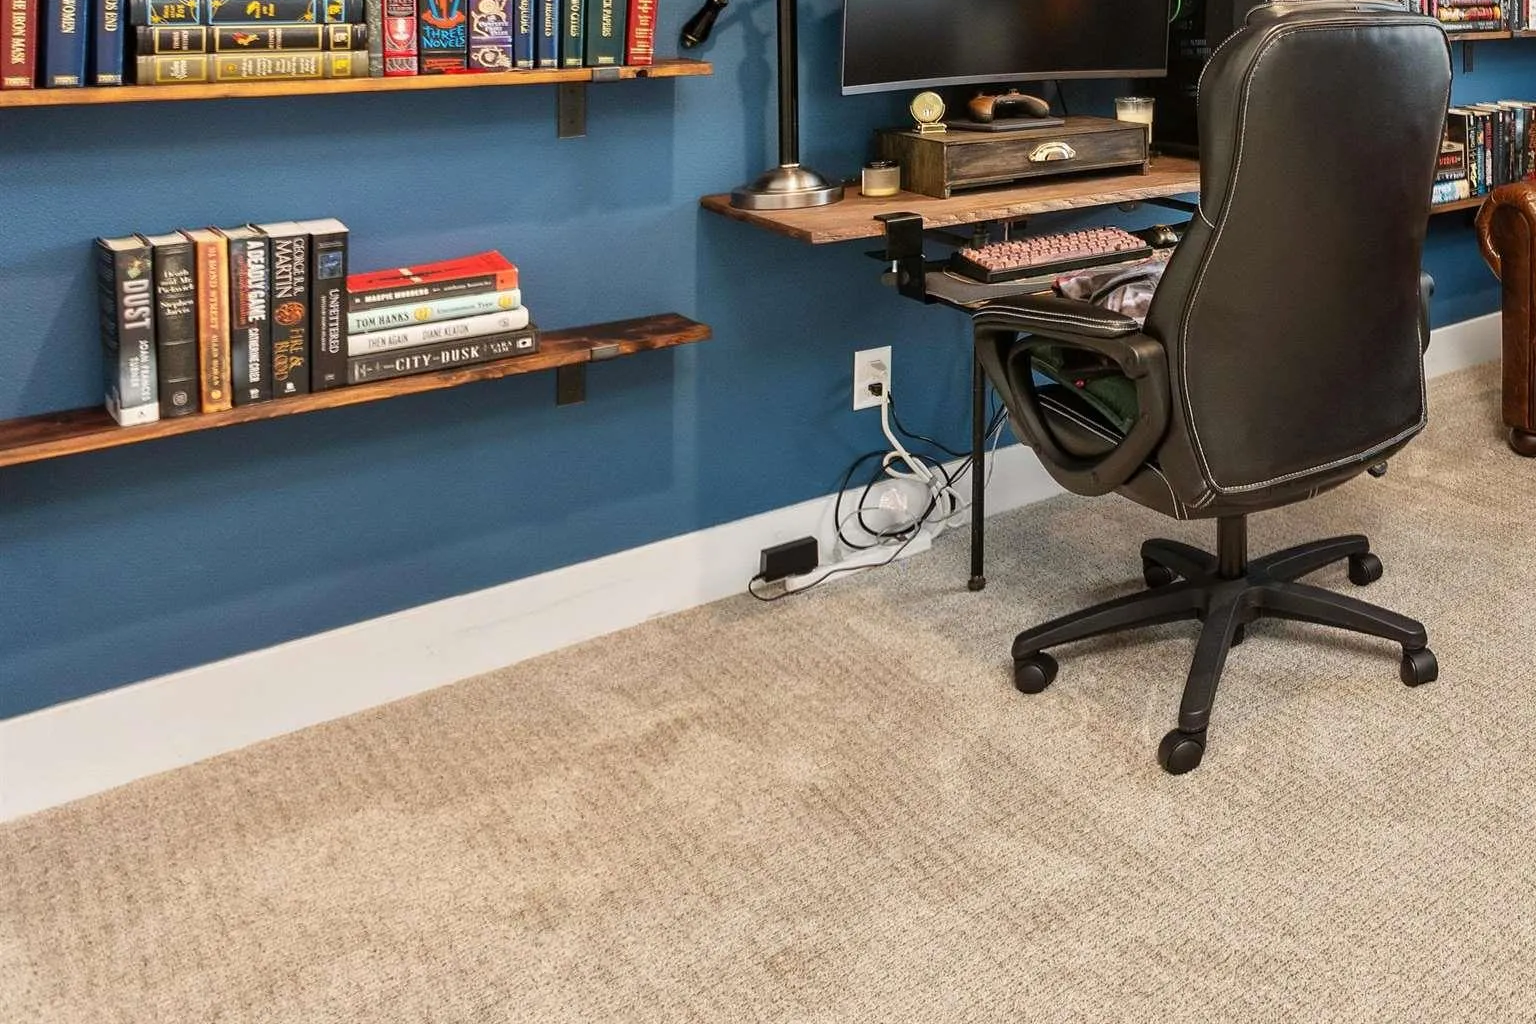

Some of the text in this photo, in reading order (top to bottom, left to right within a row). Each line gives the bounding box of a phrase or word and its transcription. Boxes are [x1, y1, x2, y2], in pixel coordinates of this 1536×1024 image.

[12, 11, 26, 36] IRON
[104, 12, 118, 31] END
[423, 27, 465, 38] THREE
[545, 3, 553, 36] HEIGHTS
[570, 12, 579, 37] CITIES
[602, 10, 612, 37] PAPERS
[11, 38, 26, 65] MASK
[423, 38, 465, 48] NOVELS
[275, 240, 293, 298] MARTIN
[293, 238, 305, 276] GEORGE
[209, 259, 218, 288] BOND
[123, 279, 150, 330] DUST
[210, 290, 219, 330] STREET
[365, 291, 393, 302] MAGPIE
[247, 241, 266, 383] A DEADLY GAME CATHERINE CRIER
[329, 288, 340, 354] UNFETTERED
[356, 312, 409, 329] TOM HANKS
[289, 328, 305, 369] FIRE &
[368, 325, 470, 348] THEN AGAIN DIANE KEATON
[274, 341, 290, 381] BLOOD
[395, 346, 480, 371] CITY DUSK
[141, 364, 151, 401] FRANCES
